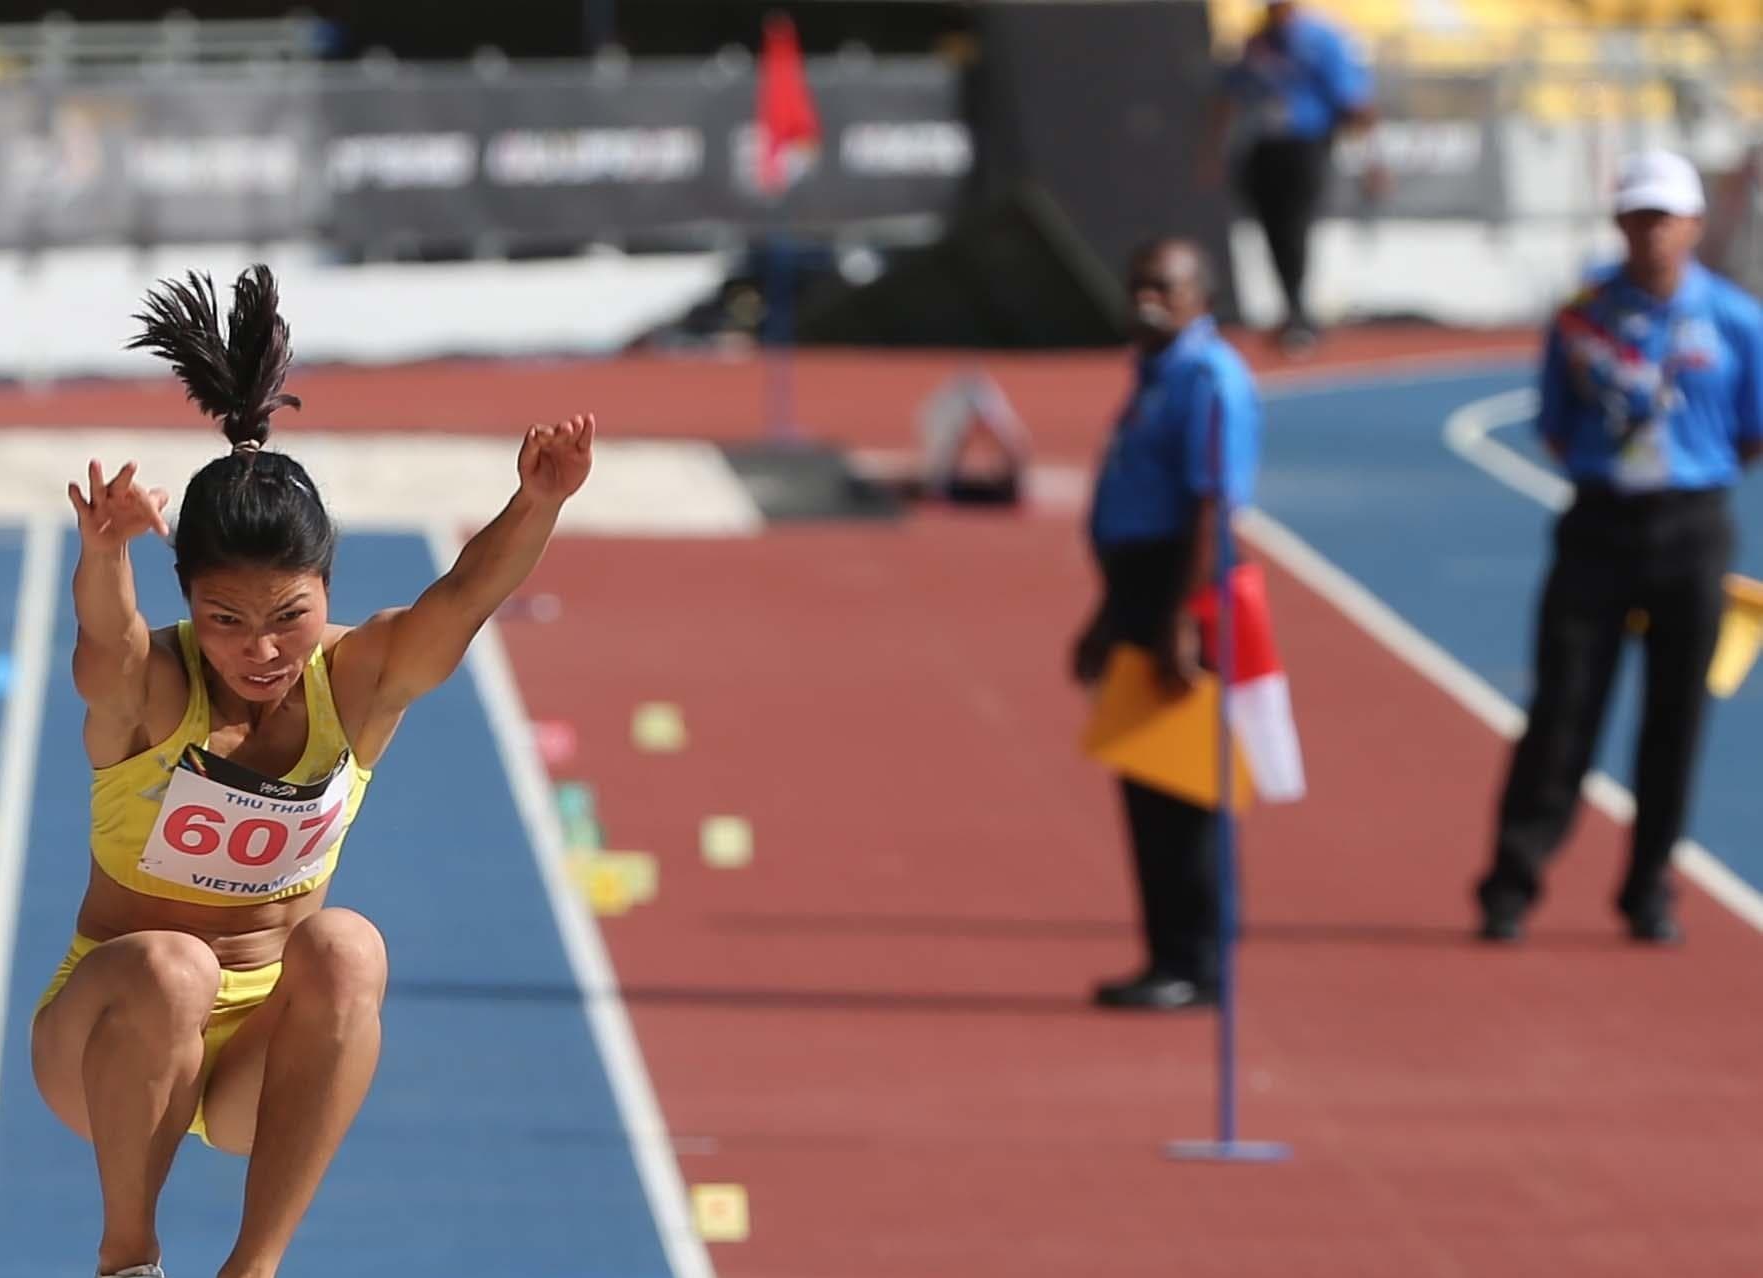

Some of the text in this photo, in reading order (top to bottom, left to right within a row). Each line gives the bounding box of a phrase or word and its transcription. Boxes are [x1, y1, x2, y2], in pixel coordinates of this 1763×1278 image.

[224, 792, 318, 815] THU THAO
[163, 799, 343, 867] 607
[191, 873, 286, 894] VIETNAM
